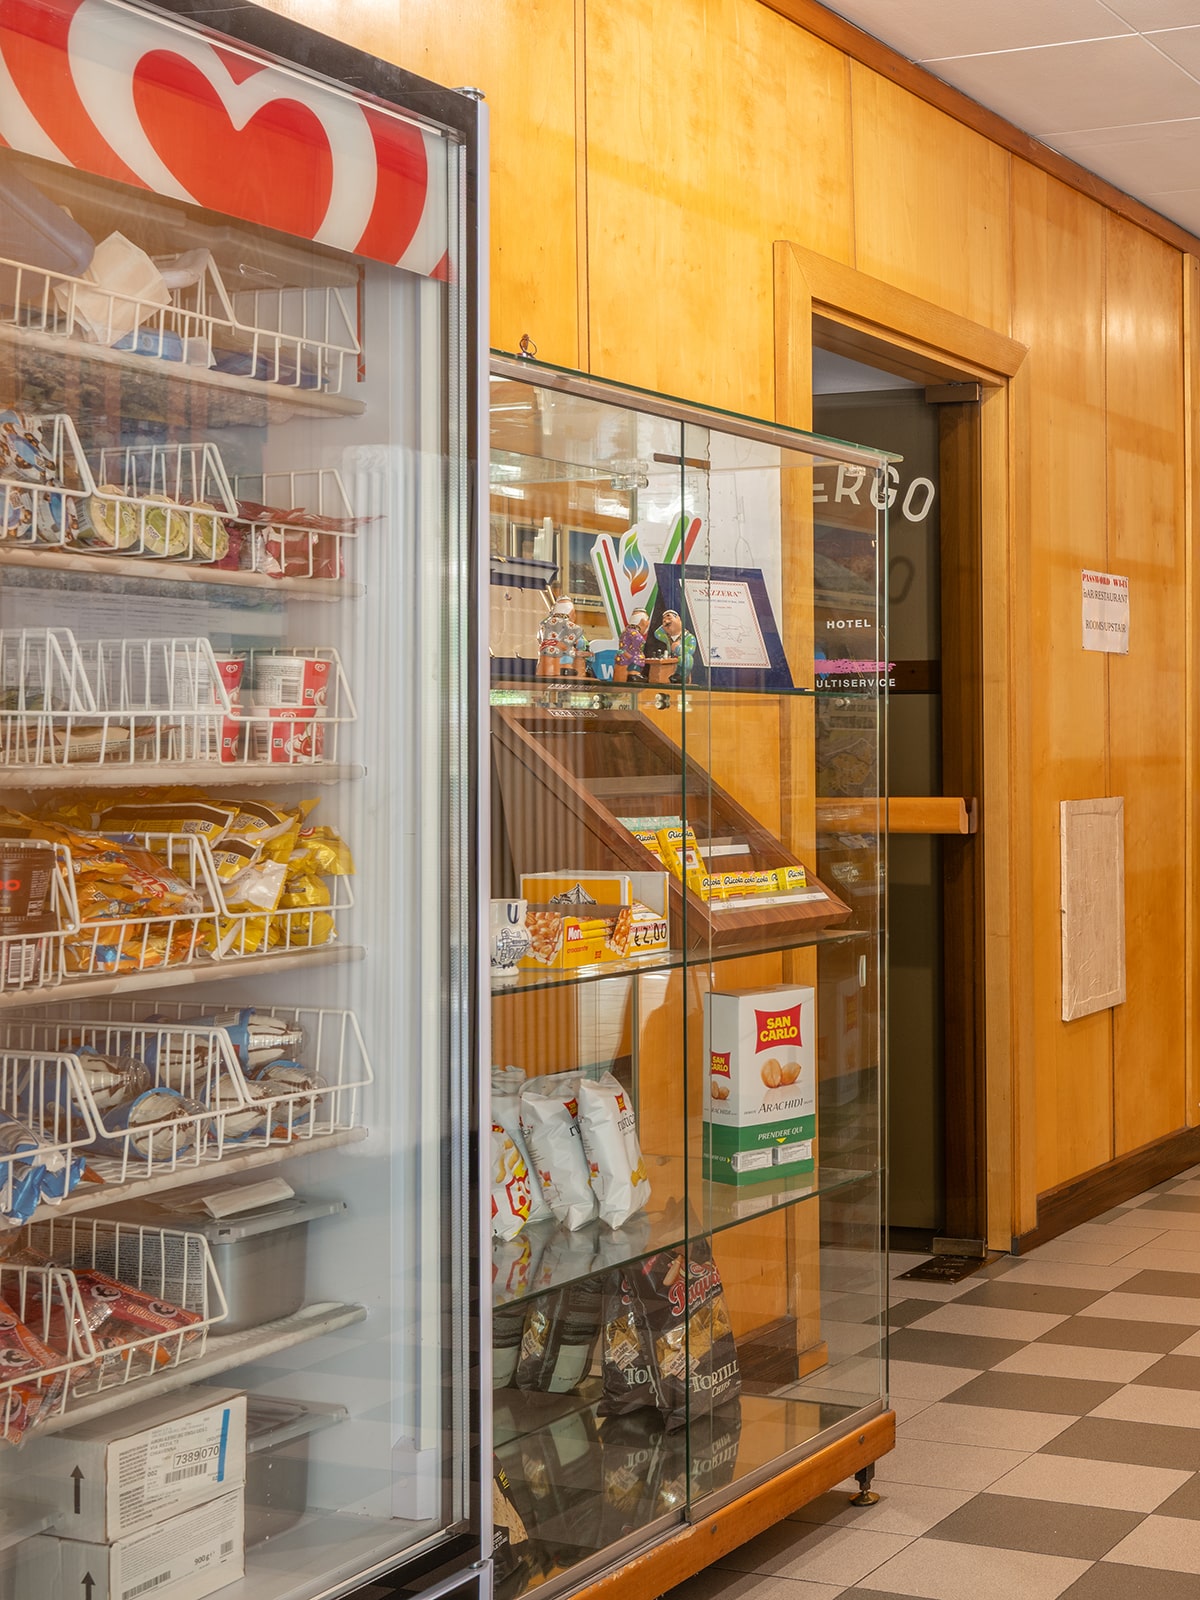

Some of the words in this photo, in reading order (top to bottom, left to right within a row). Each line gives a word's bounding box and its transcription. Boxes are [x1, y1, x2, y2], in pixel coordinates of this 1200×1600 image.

[1082, 573, 1111, 586] PASSWORD
[826, 619, 871, 629] HOTEL
[816, 678, 896, 688] ULTISERVCE
[668, 830, 693, 839] Ricla
[724, 876, 743, 885] Ricola
[766, 1015, 791, 1030] SAN
[760, 1026, 798, 1042] CARLO
[712, 1056, 725, 1065] SAN
[758, 1098, 803, 1113] ARACHIDI
[758, 1128, 791, 1140] PRENDERE
[791, 1126, 803, 1135] QUI
[691, 1359, 740, 1393] TORTILL
[175, 1450, 200, 1466] 7389
[201, 1445, 219, 1459] 070
